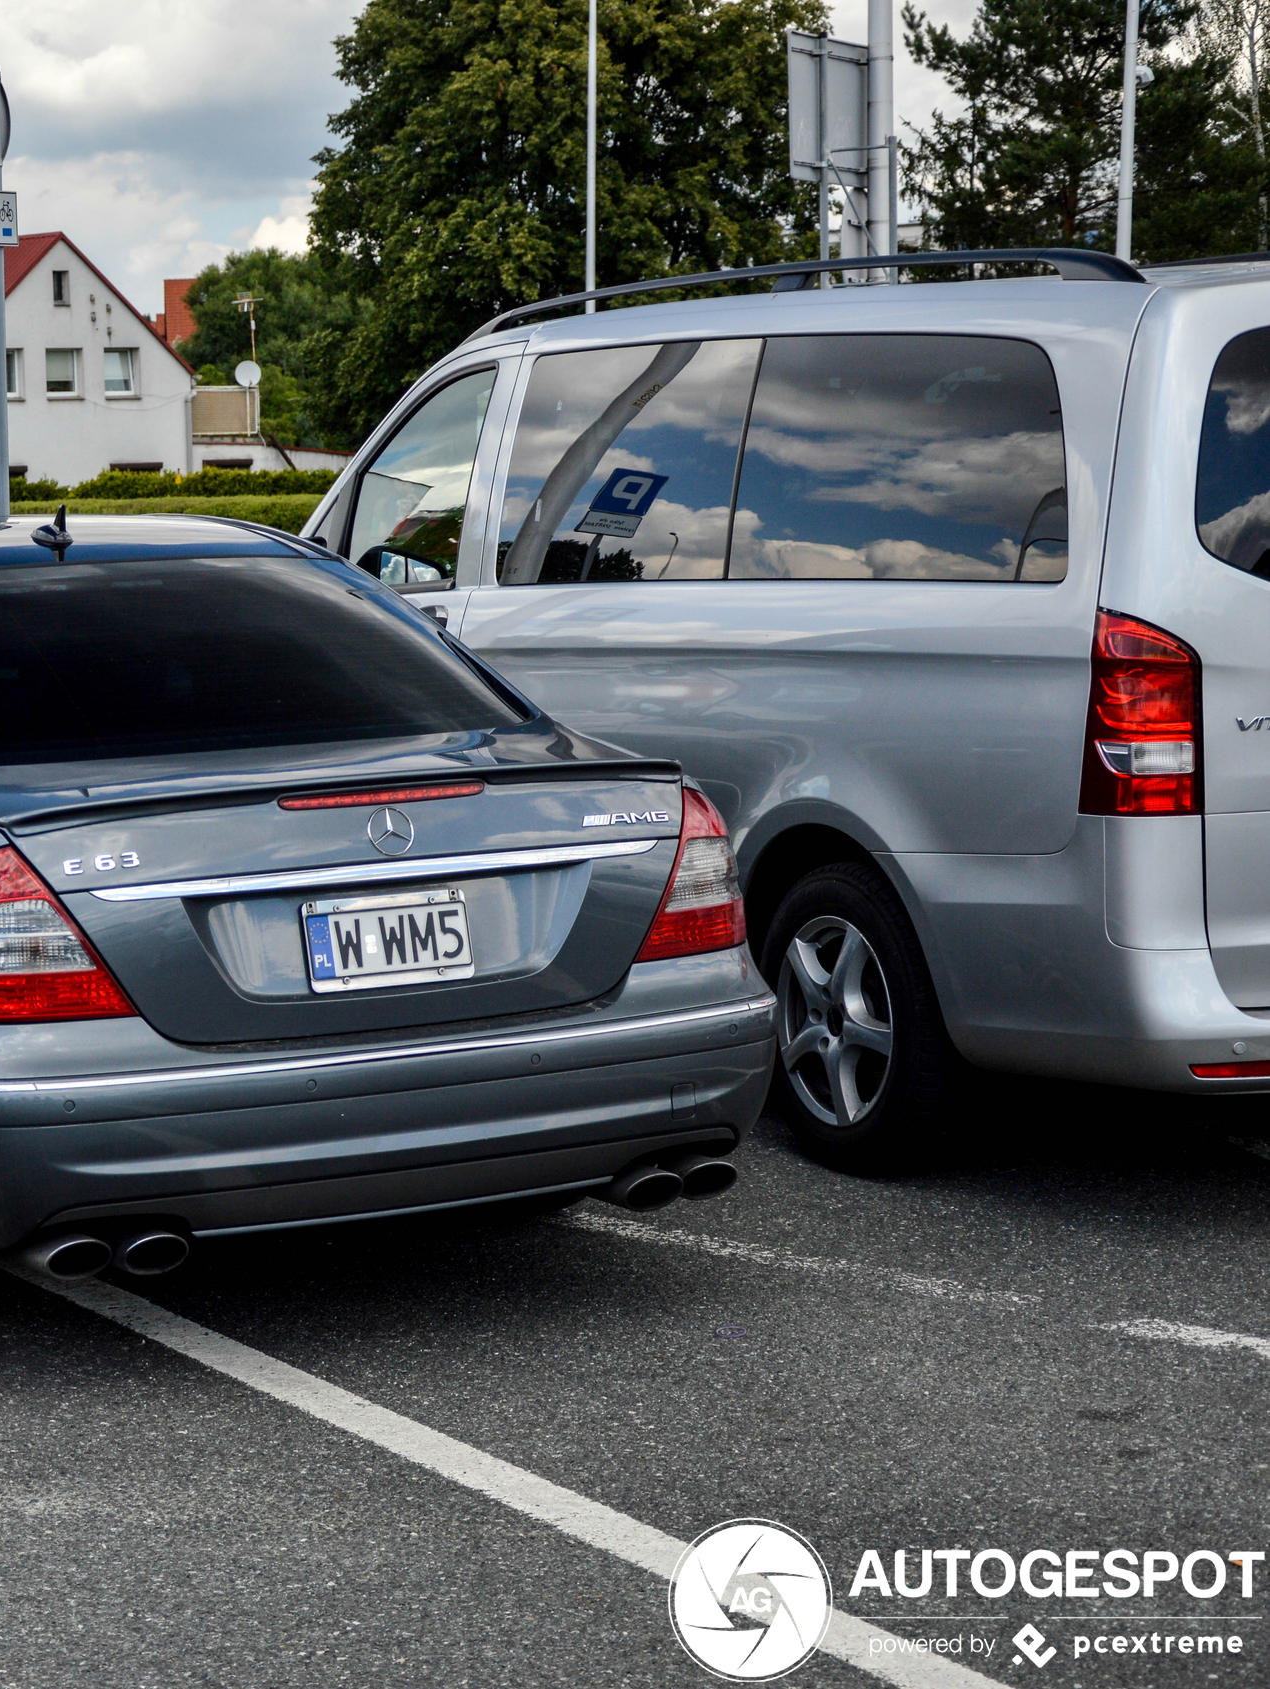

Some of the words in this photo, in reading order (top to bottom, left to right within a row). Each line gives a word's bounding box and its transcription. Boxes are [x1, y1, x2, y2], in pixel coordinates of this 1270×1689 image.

[610, 810, 670, 826] AMG
[63, 858, 85, 876] E
[93, 851, 141, 872] 63
[334, 918, 364, 970] W
[378, 909, 465, 966] WM5
[314, 954, 332, 969] PL
